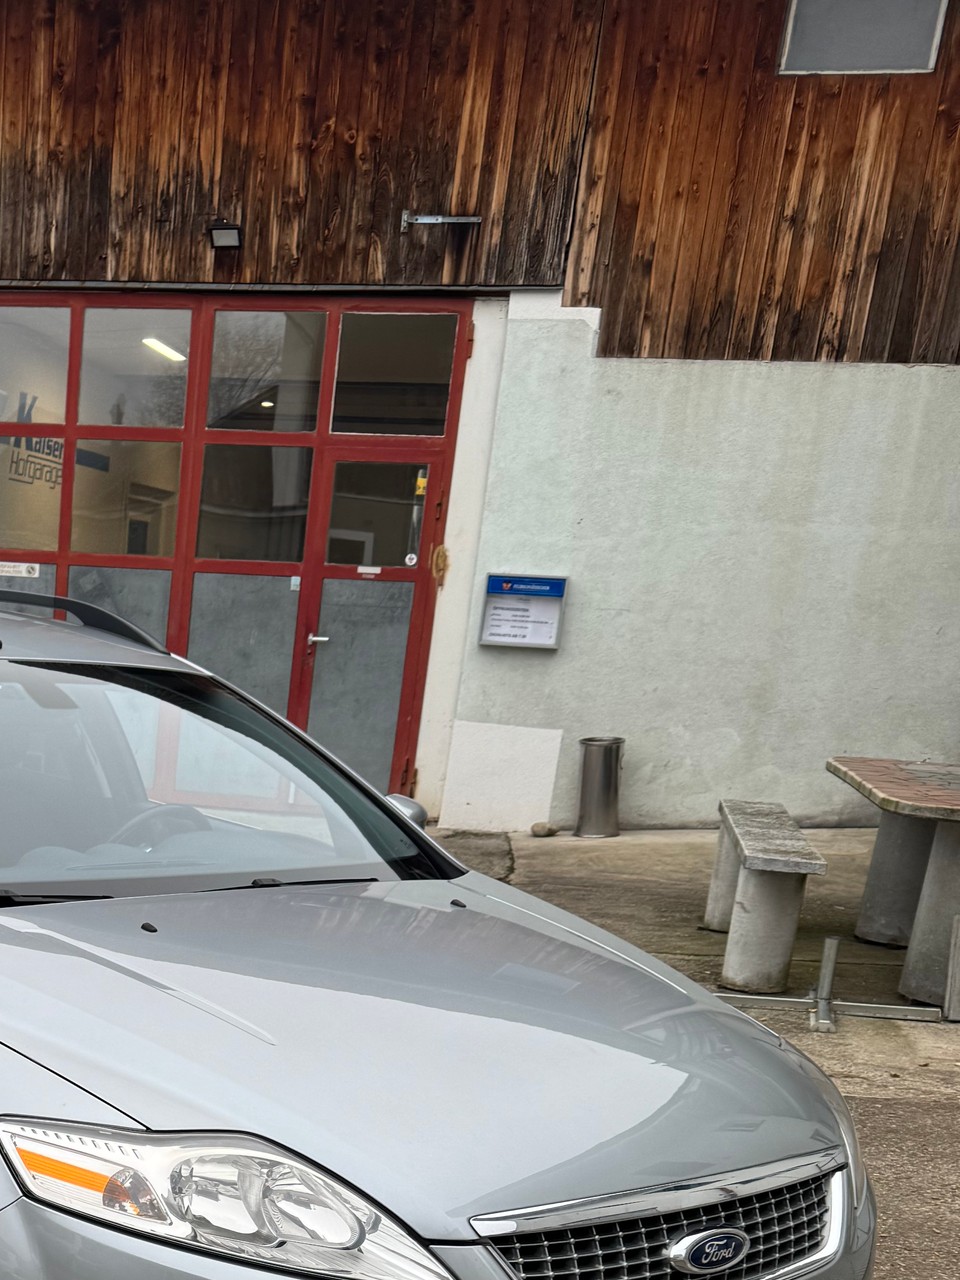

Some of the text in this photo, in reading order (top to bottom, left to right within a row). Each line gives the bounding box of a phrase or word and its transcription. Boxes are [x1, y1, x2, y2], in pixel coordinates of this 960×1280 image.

[14, 391, 64, 460] Kaiser
[9, 449, 62, 489] Hofgarage
[701, 1239, 735, 1264] Ford
